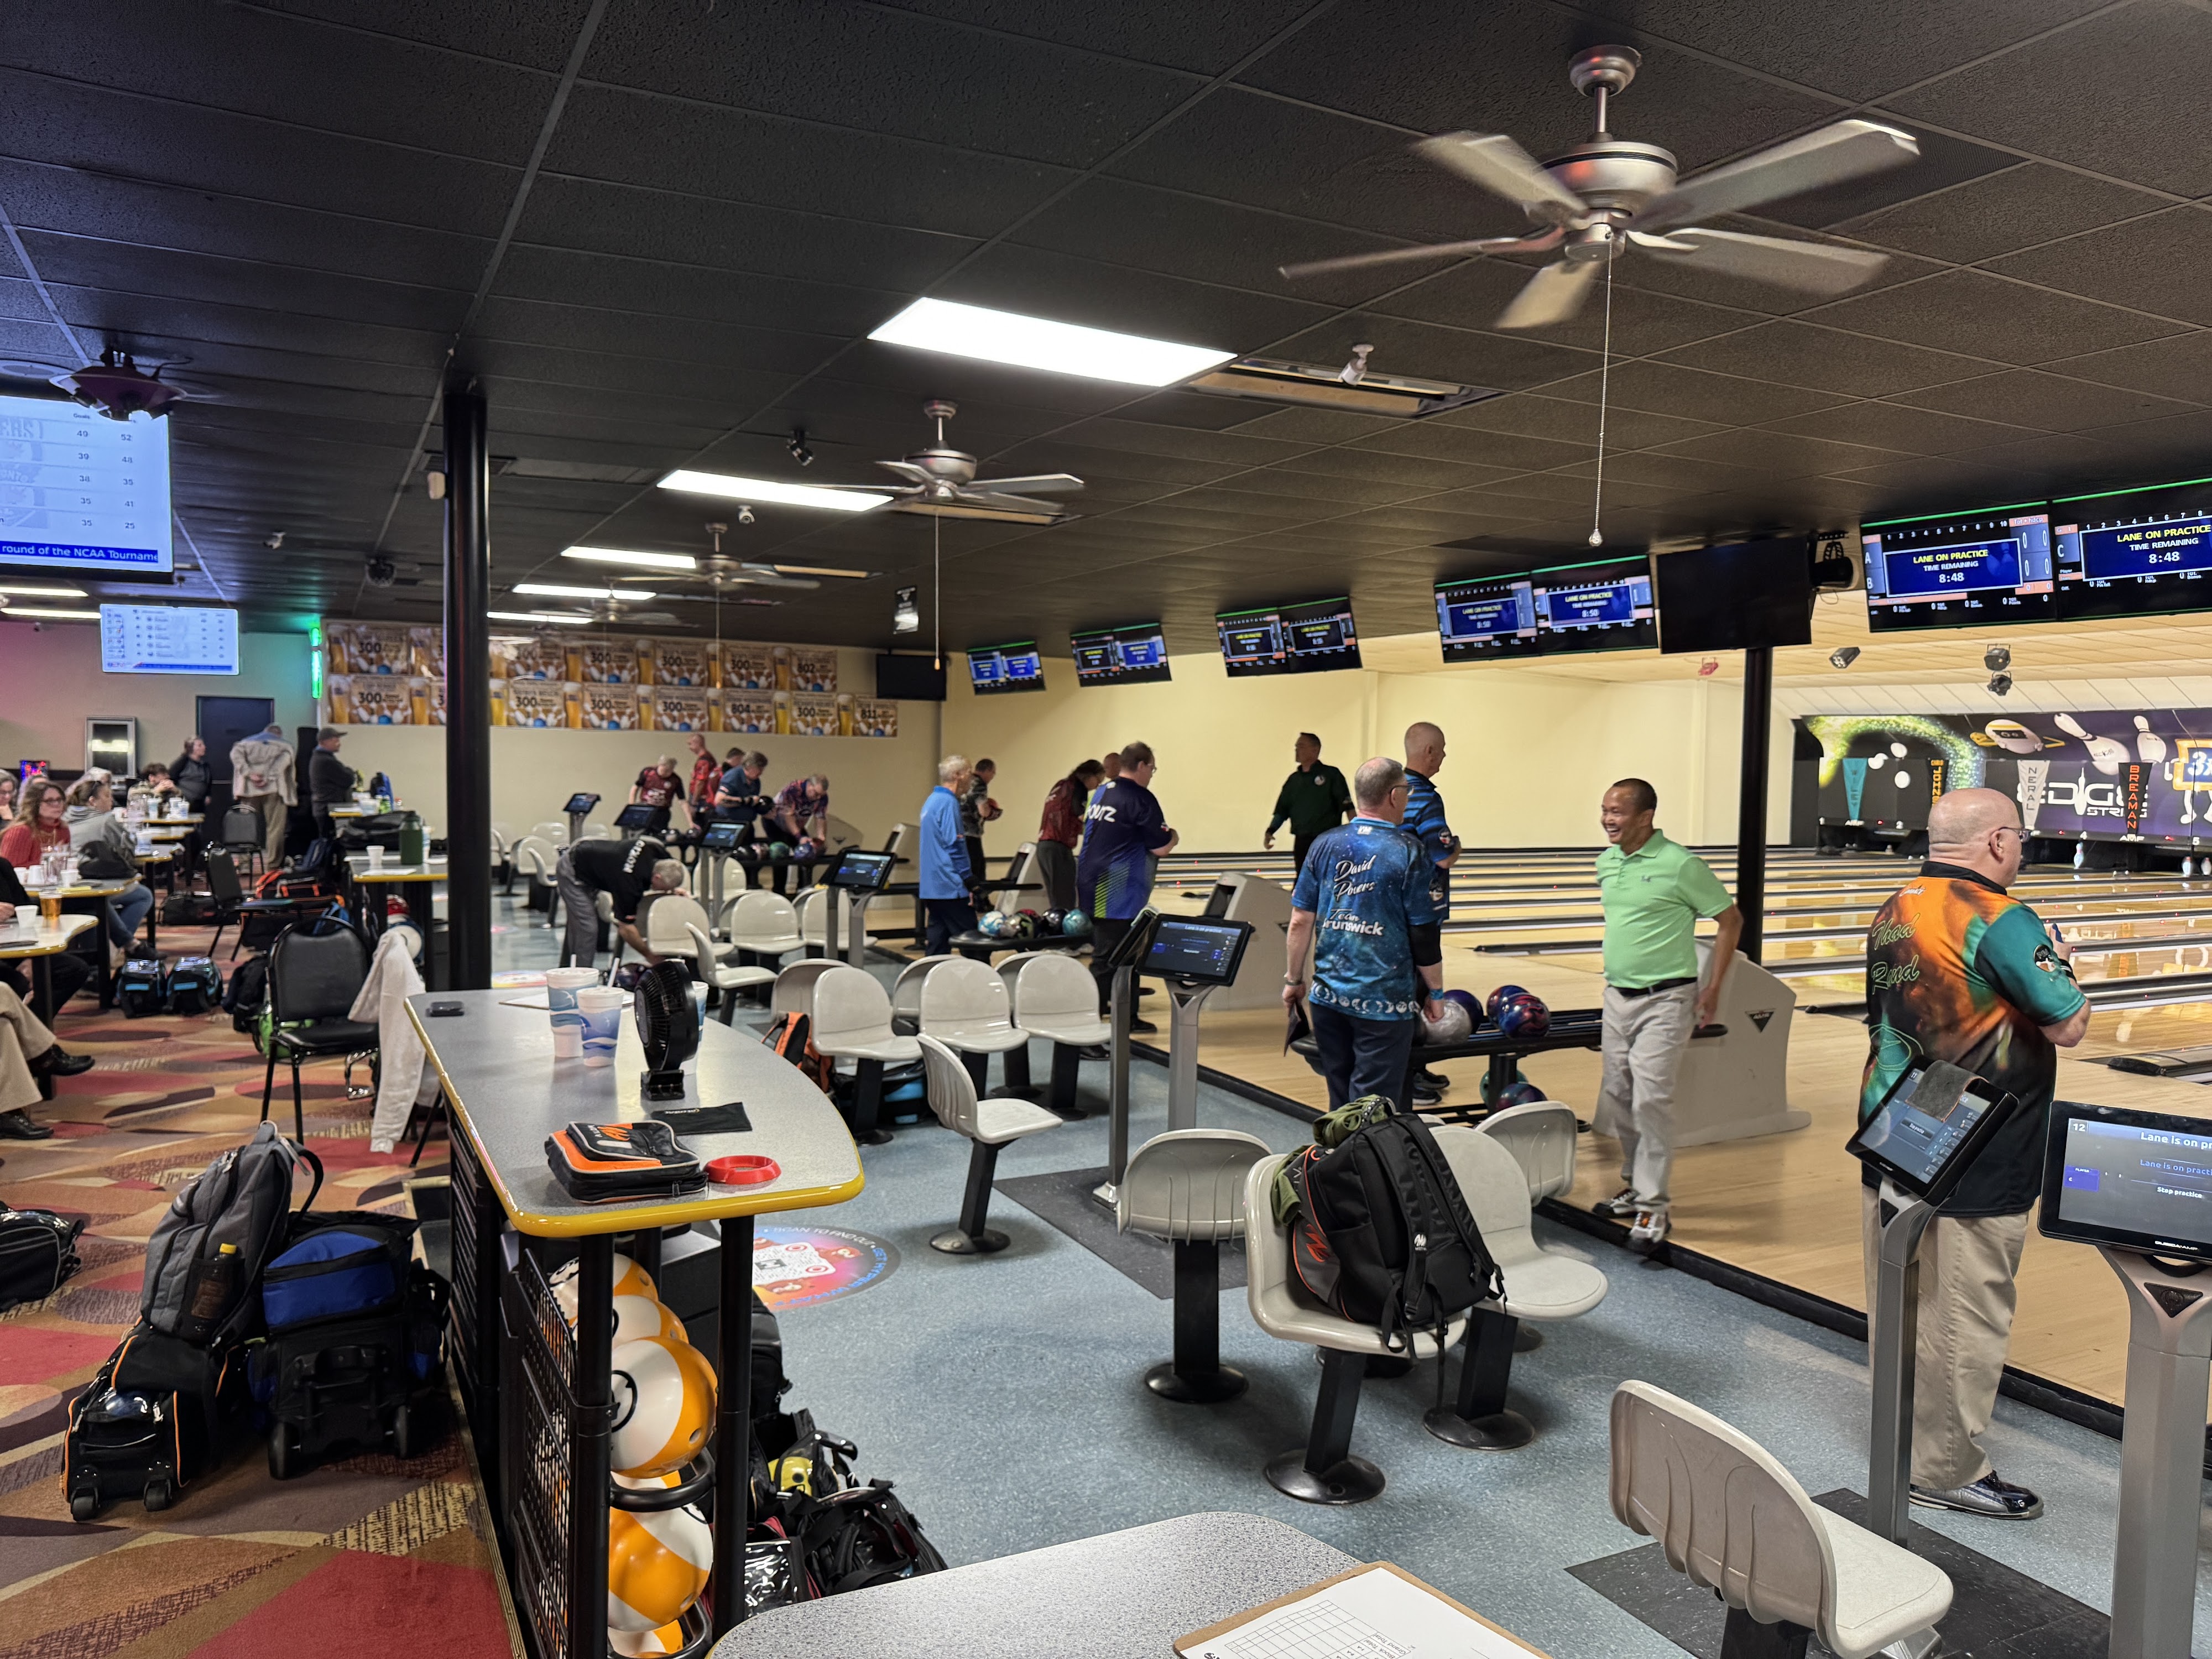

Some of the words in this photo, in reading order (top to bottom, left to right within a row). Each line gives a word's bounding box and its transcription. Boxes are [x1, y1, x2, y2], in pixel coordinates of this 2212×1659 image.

[2028, 517, 2043, 525] hdcp
[2117, 533, 2142, 542] LANE
[2146, 530, 2161, 539] ON
[2164, 524, 2211, 537] PRACTICE
[2023, 532, 2027, 549] 0
[2042, 530, 2047, 546] 0
[2130, 542, 2149, 551] TIME
[2152, 538, 2198, 549] REMAINING
[2, 545, 34, 554] round
[38, 546, 50, 555] of
[52, 547, 71, 556] the
[74, 549, 105, 558] NCAA
[2057, 545, 2064, 557] C
[1865, 552, 1871, 564] A
[1913, 555, 1934, 564] LANE
[1951, 550, 1988, 560] PRACTICE
[2149, 551, 2180, 564] 8:48
[1941, 561, 1979, 570] REMAINING
[2025, 560, 2029, 576] 0
[2045, 558, 2049, 574] 0
[1939, 572, 1964, 583] 8:48
[1866, 578, 1873, 589] B
[359, 643, 382, 653] 300
[358, 692, 382, 703] 300
[516, 697, 537, 707] 300
[592, 700, 612, 709] 300
[662, 702, 682, 712] 300
[797, 708, 815, 717] 300
[2127, 765, 2140, 829] BREAMAN
[1087, 804, 1117, 822] OUTZ
[1819, 817, 1825, 825] 1
[1896, 821, 1903, 830] 2
[2080, 831, 2087, 840] 4
[2193, 837, 2199, 845] 5
[1334, 855, 1377, 882] David
[1331, 908, 1360, 921] Team
[2073, 1123, 2085, 1131] 12
[2141, 1132, 2168, 1143] Lane
[2171, 1135, 2180, 1145] is
[2183, 1139, 2198, 1147] on
[2140, 1159, 2161, 1168] Lane
[2163, 1160, 2171, 1170] is
[2174, 1189, 2203, 1199] practice
[1363, 1639, 1378, 1649] Total
[1373, 1634, 1387, 1644] Total
[1387, 1642, 1406, 1655] Grand
